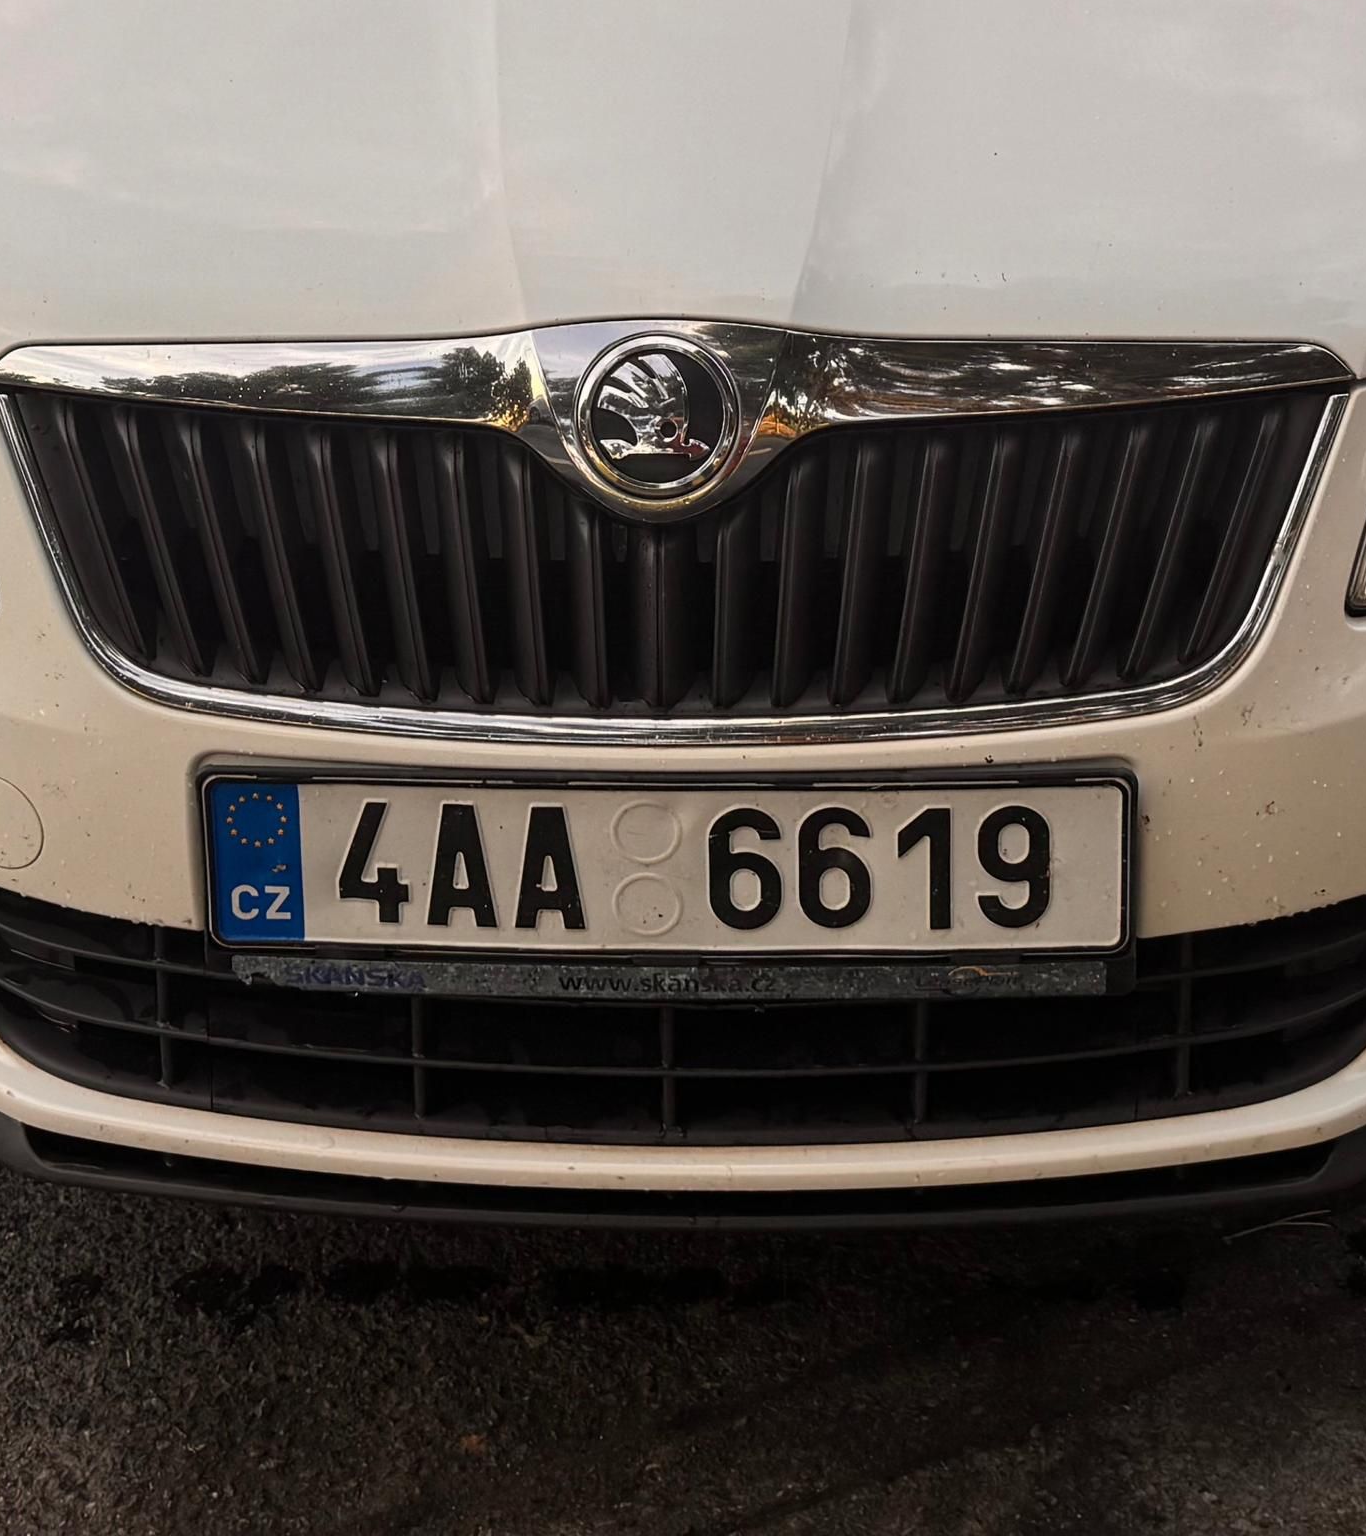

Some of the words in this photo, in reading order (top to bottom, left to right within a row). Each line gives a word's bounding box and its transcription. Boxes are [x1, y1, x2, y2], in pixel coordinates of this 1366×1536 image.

[338, 802, 586, 930] 4AA
[708, 805, 1051, 930] 6619
[231, 884, 292, 921] CZ
[283, 963, 427, 992] SKANSKA
[559, 972, 778, 994] www.skanska.cz
